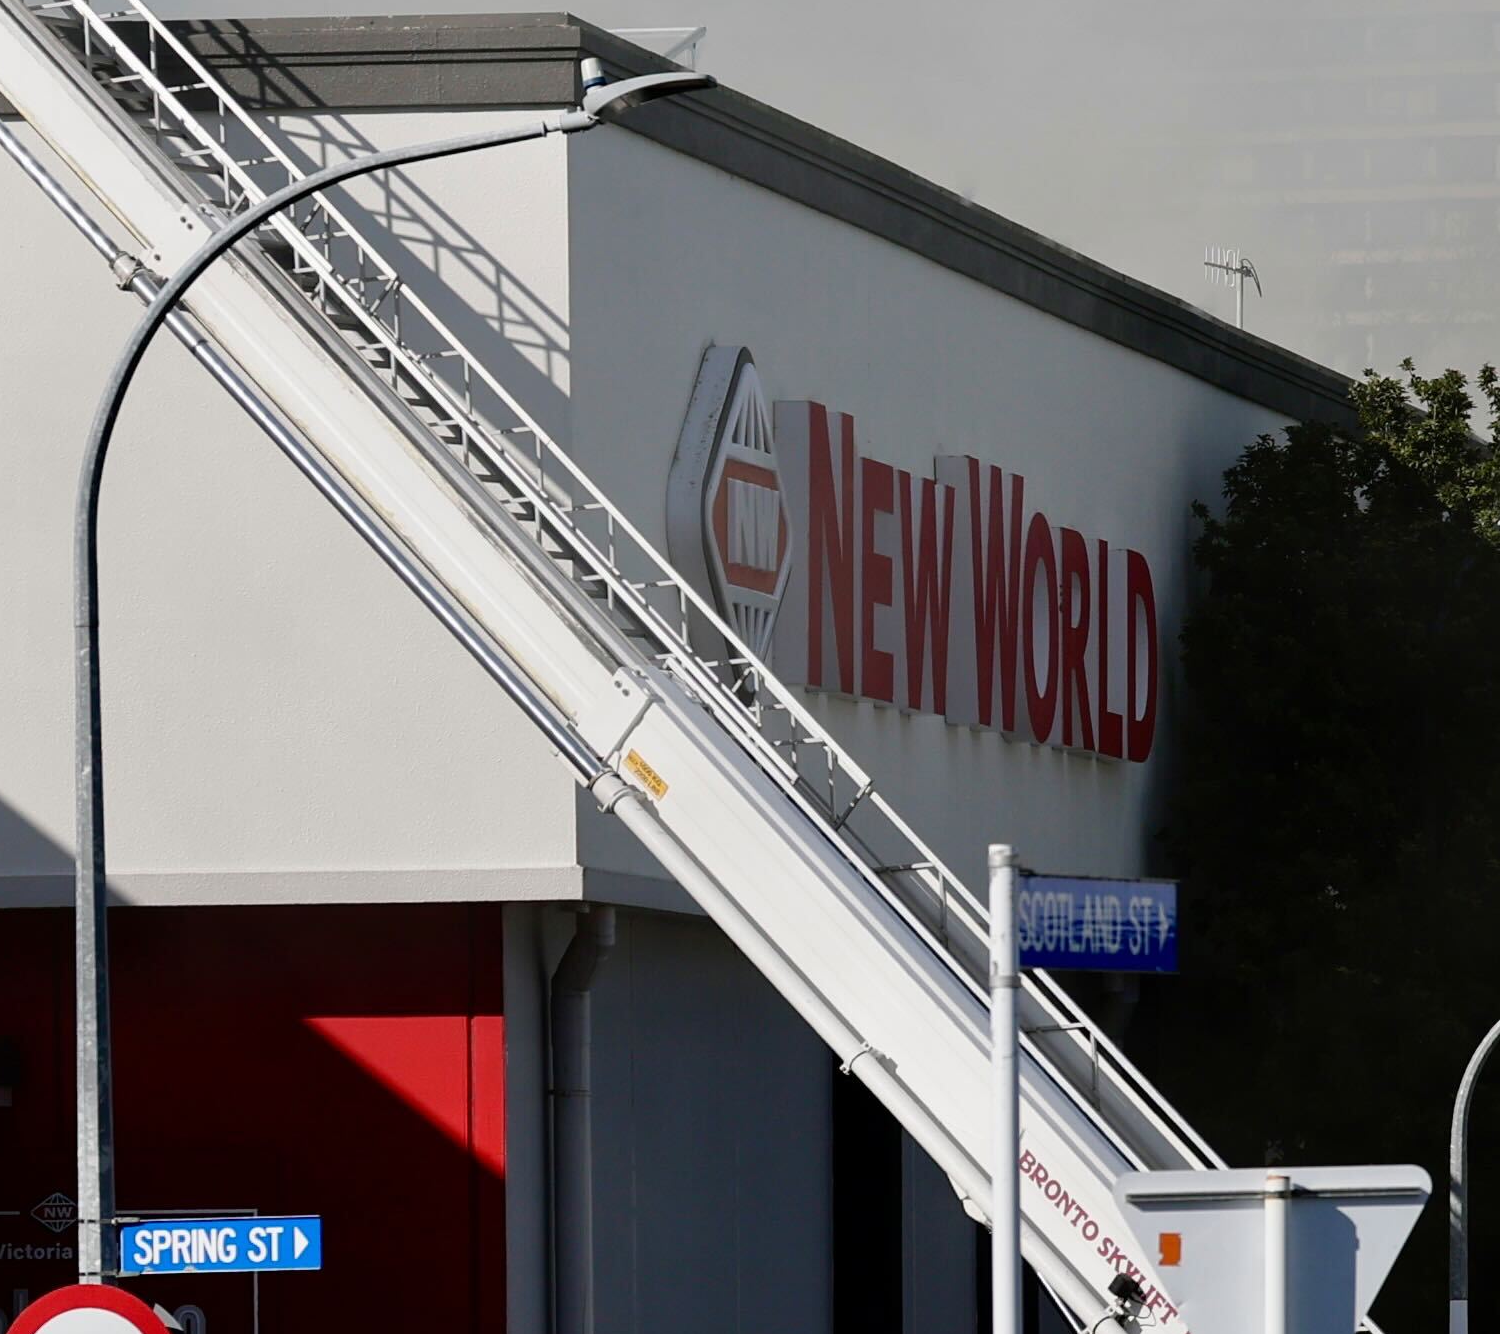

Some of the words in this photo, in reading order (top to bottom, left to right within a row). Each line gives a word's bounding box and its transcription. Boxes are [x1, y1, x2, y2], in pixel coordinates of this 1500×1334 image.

[808, 401, 954, 715] NEW
[967, 456, 1158, 763] WORLD
[1019, 890, 1122, 954] SCOTLAND
[1129, 896, 1153, 955] ST
[43, 1206, 74, 1220] NW
[1018, 1148, 1100, 1242] BRONTO
[133, 1227, 238, 1265] SPRING
[247, 1226, 284, 1263] ST
